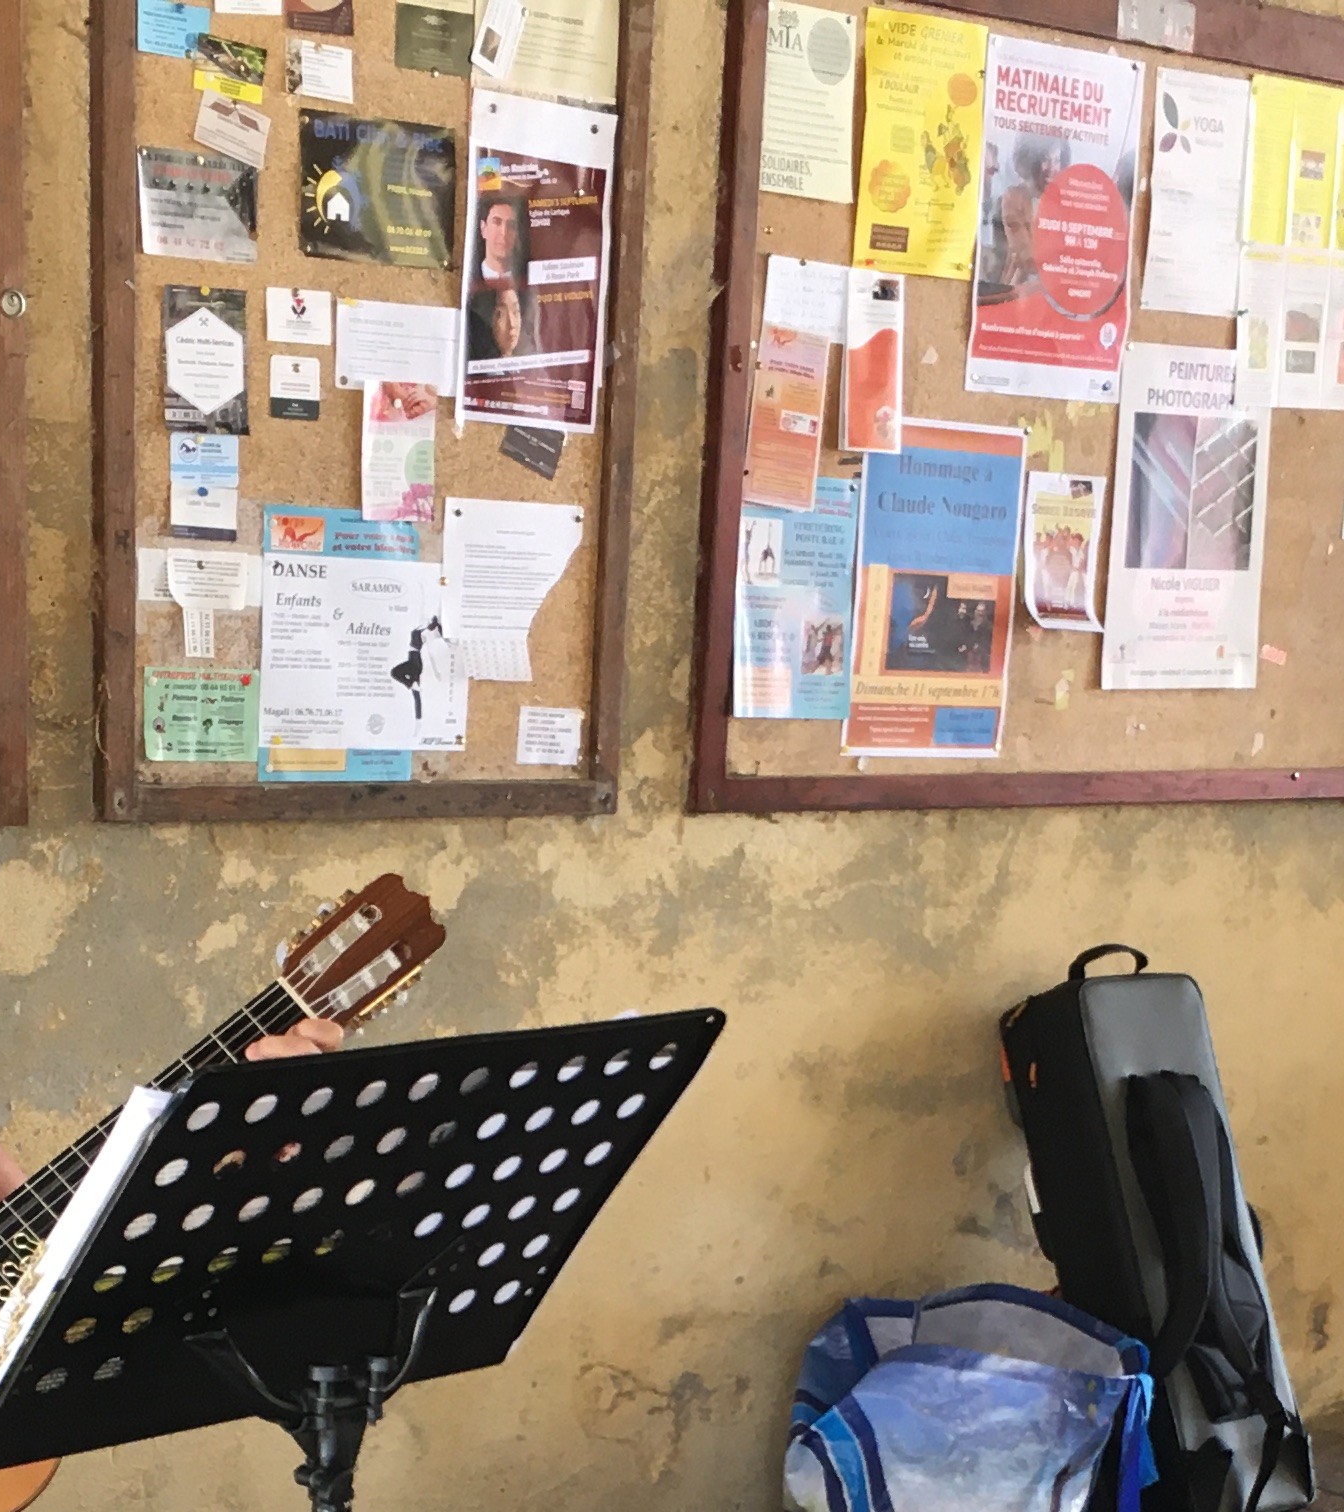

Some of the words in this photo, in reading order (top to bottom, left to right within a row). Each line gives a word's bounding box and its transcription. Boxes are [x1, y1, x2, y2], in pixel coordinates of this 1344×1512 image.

[888, 21, 916, 36] VIDE
[921, 26, 964, 44] GRENIER
[996, 64, 1080, 99] MATINALE
[1083, 80, 1104, 103] DU
[995, 89, 1111, 128] RECRUTEMENT
[313, 119, 349, 141] BATI
[994, 116, 1017, 130] TOUS
[1018, 120, 1063, 138] SECTEURS
[1193, 116, 1224, 134] YOGA
[762, 155, 812, 176] SOLIDAIRES,
[762, 171, 804, 191] ENSEMBLE
[1038, 218, 1061, 232] JEUDI
[1069, 222, 1114, 238] SEPTEMBRE
[899, 454, 980, 484] Hommage
[983, 462, 993, 482] à
[877, 491, 935, 515] Claude
[941, 496, 1007, 520] Nougaro
[272, 562, 327, 579] DANSE
[351, 583, 402, 593] SARAMON
[1151, 577, 1181, 591] Nicole
[276, 593, 322, 610] Enfants
[332, 608, 344, 620] &
[346, 622, 391, 636] Adultes
[856, 681, 910, 696] Dimanche
[928, 685, 977, 700] septembre
[264, 707, 289, 716] Magali
